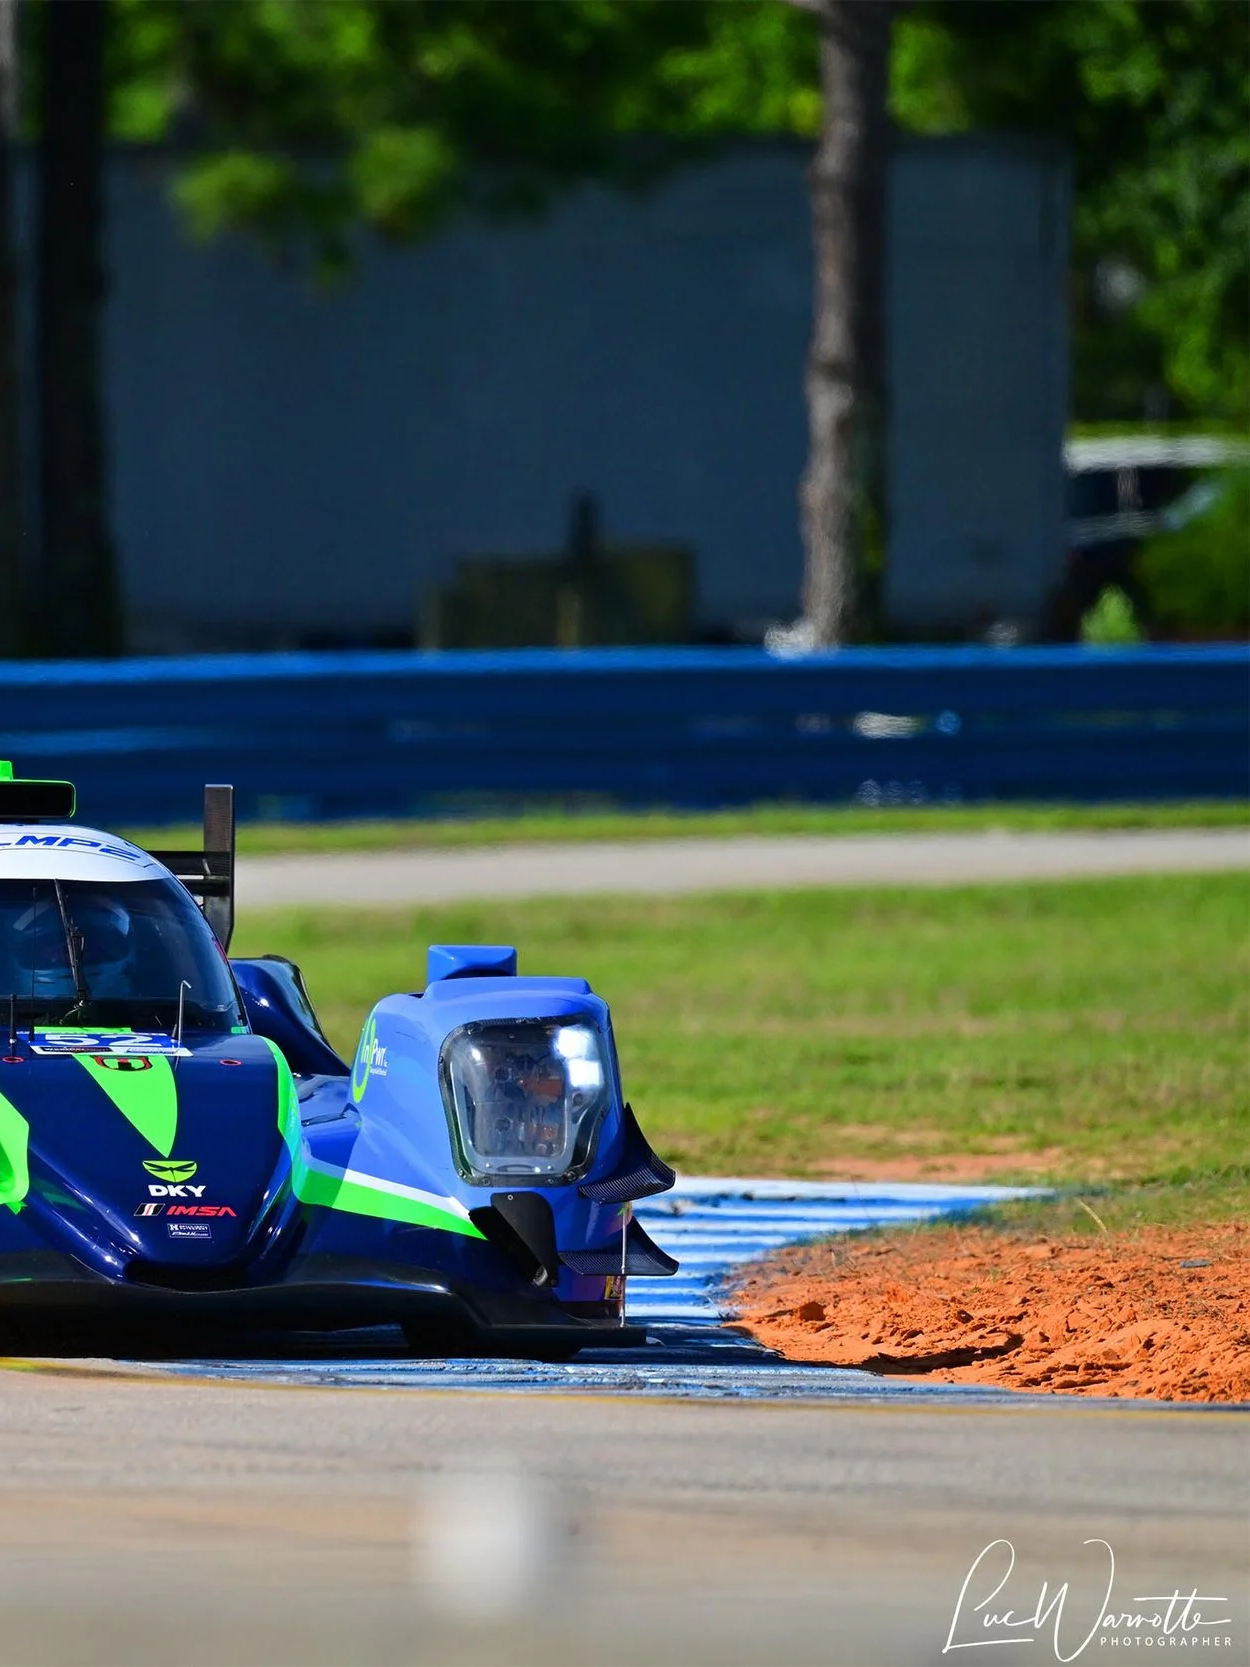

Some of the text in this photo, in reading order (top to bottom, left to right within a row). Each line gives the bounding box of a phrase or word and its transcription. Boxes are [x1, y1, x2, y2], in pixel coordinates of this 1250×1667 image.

[45, 1034, 162, 1047] 52
[148, 1185, 206, 1197] DKY
[166, 1205, 237, 1217] IMSA
